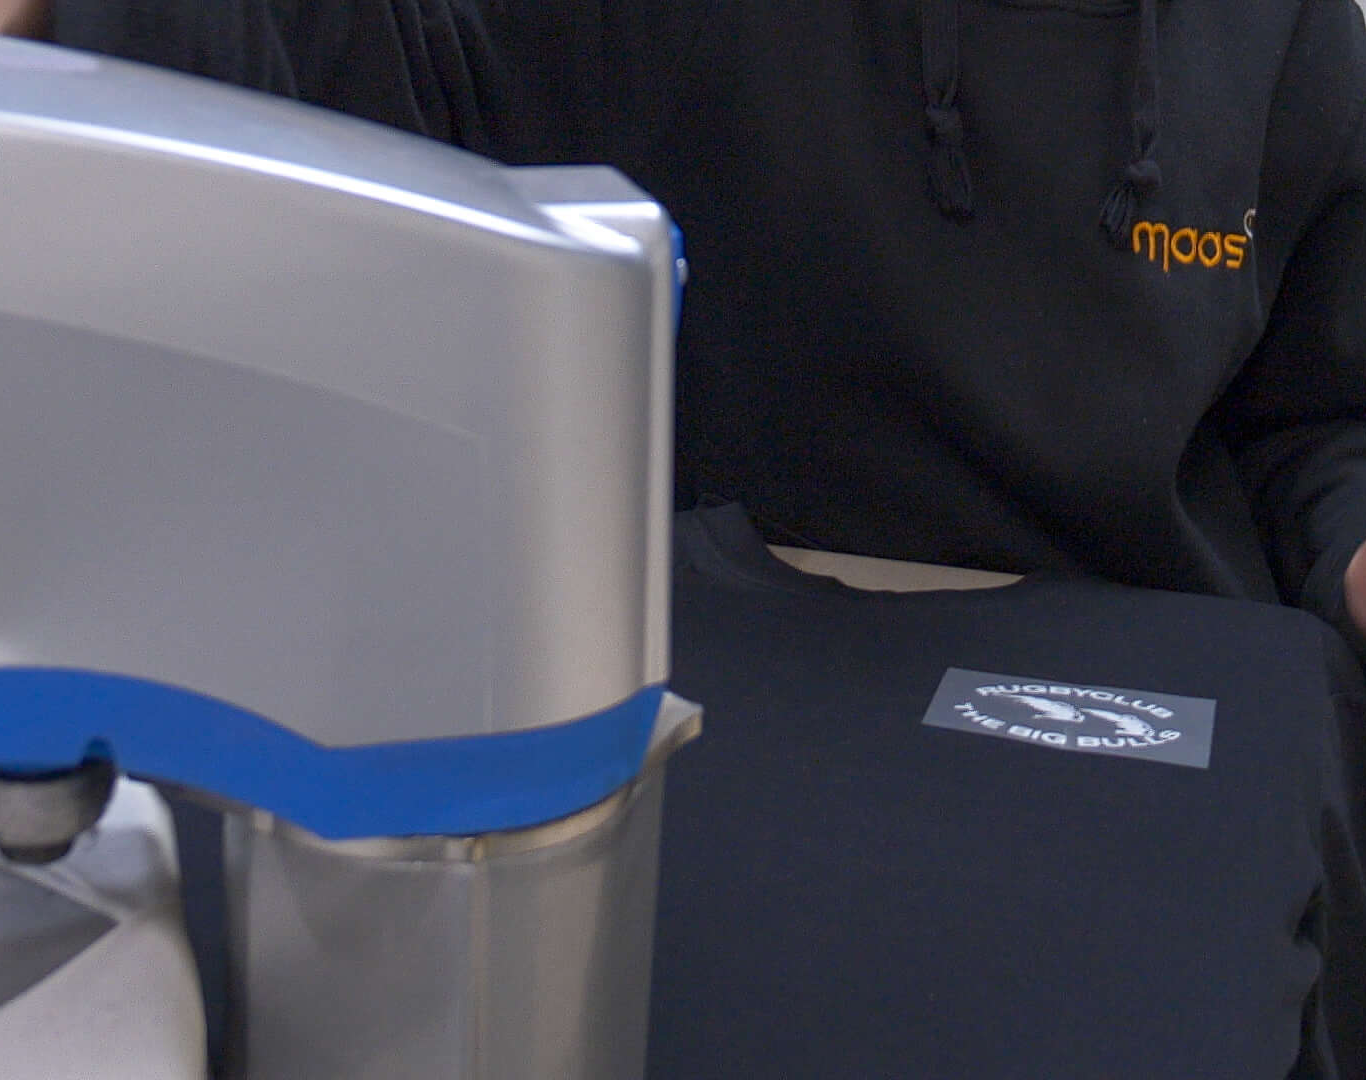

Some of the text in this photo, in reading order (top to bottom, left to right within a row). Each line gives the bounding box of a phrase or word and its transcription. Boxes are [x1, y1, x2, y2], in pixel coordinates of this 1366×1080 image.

[975, 684, 1175, 719] RUGBYCLUB
[954, 701, 1182, 749] THE BIG BULLS
